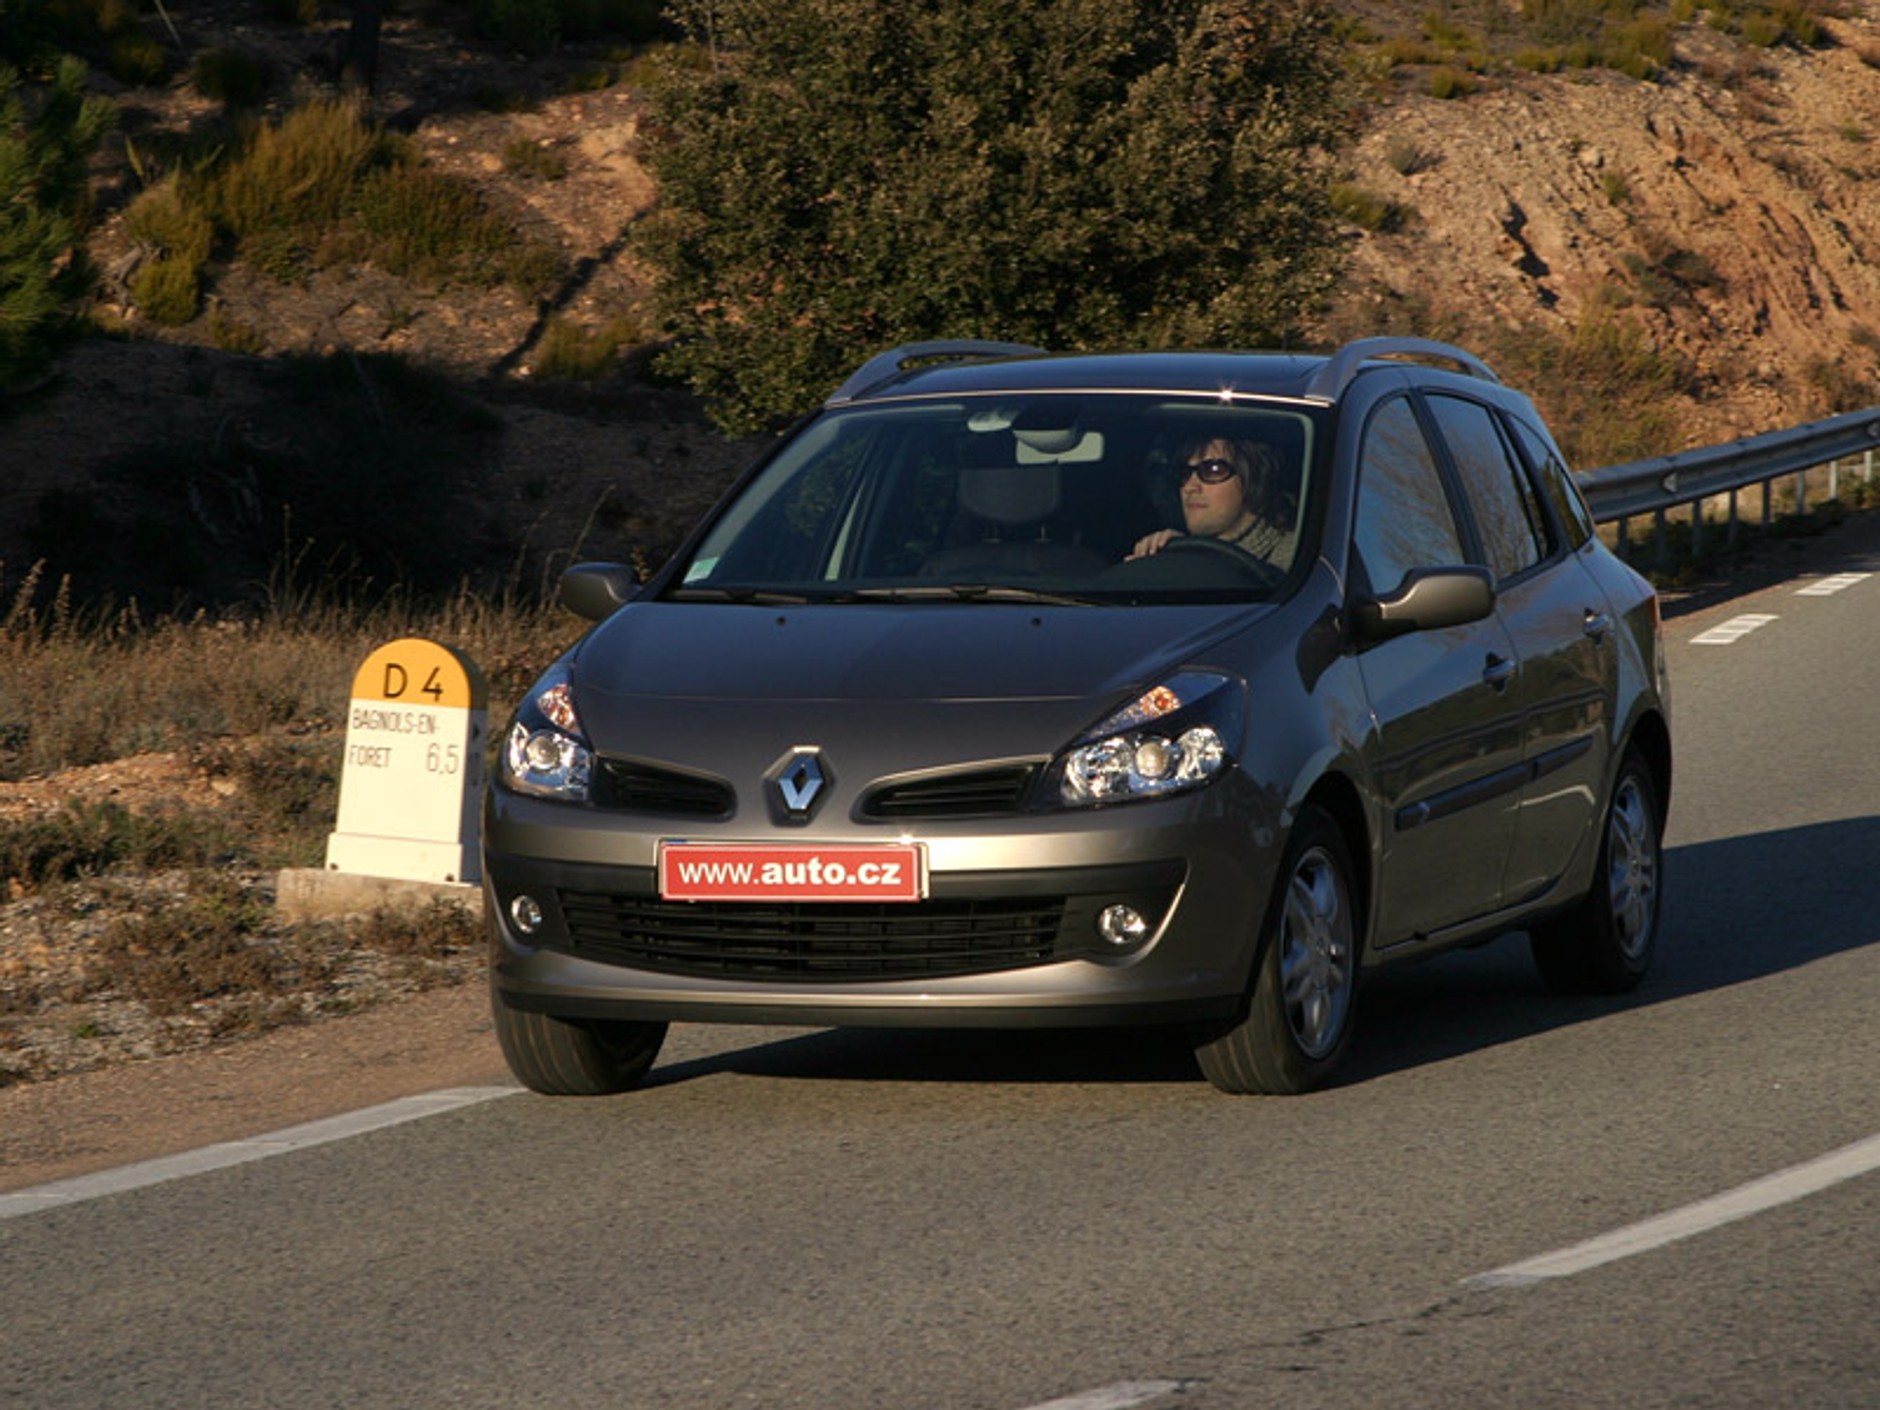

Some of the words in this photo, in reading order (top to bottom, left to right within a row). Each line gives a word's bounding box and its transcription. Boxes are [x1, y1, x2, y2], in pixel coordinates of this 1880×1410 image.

[383, 663, 408, 699] D
[421, 666, 444, 702] 4
[348, 744, 392, 768] FORET
[678, 857, 901, 884] www.auto.cz
